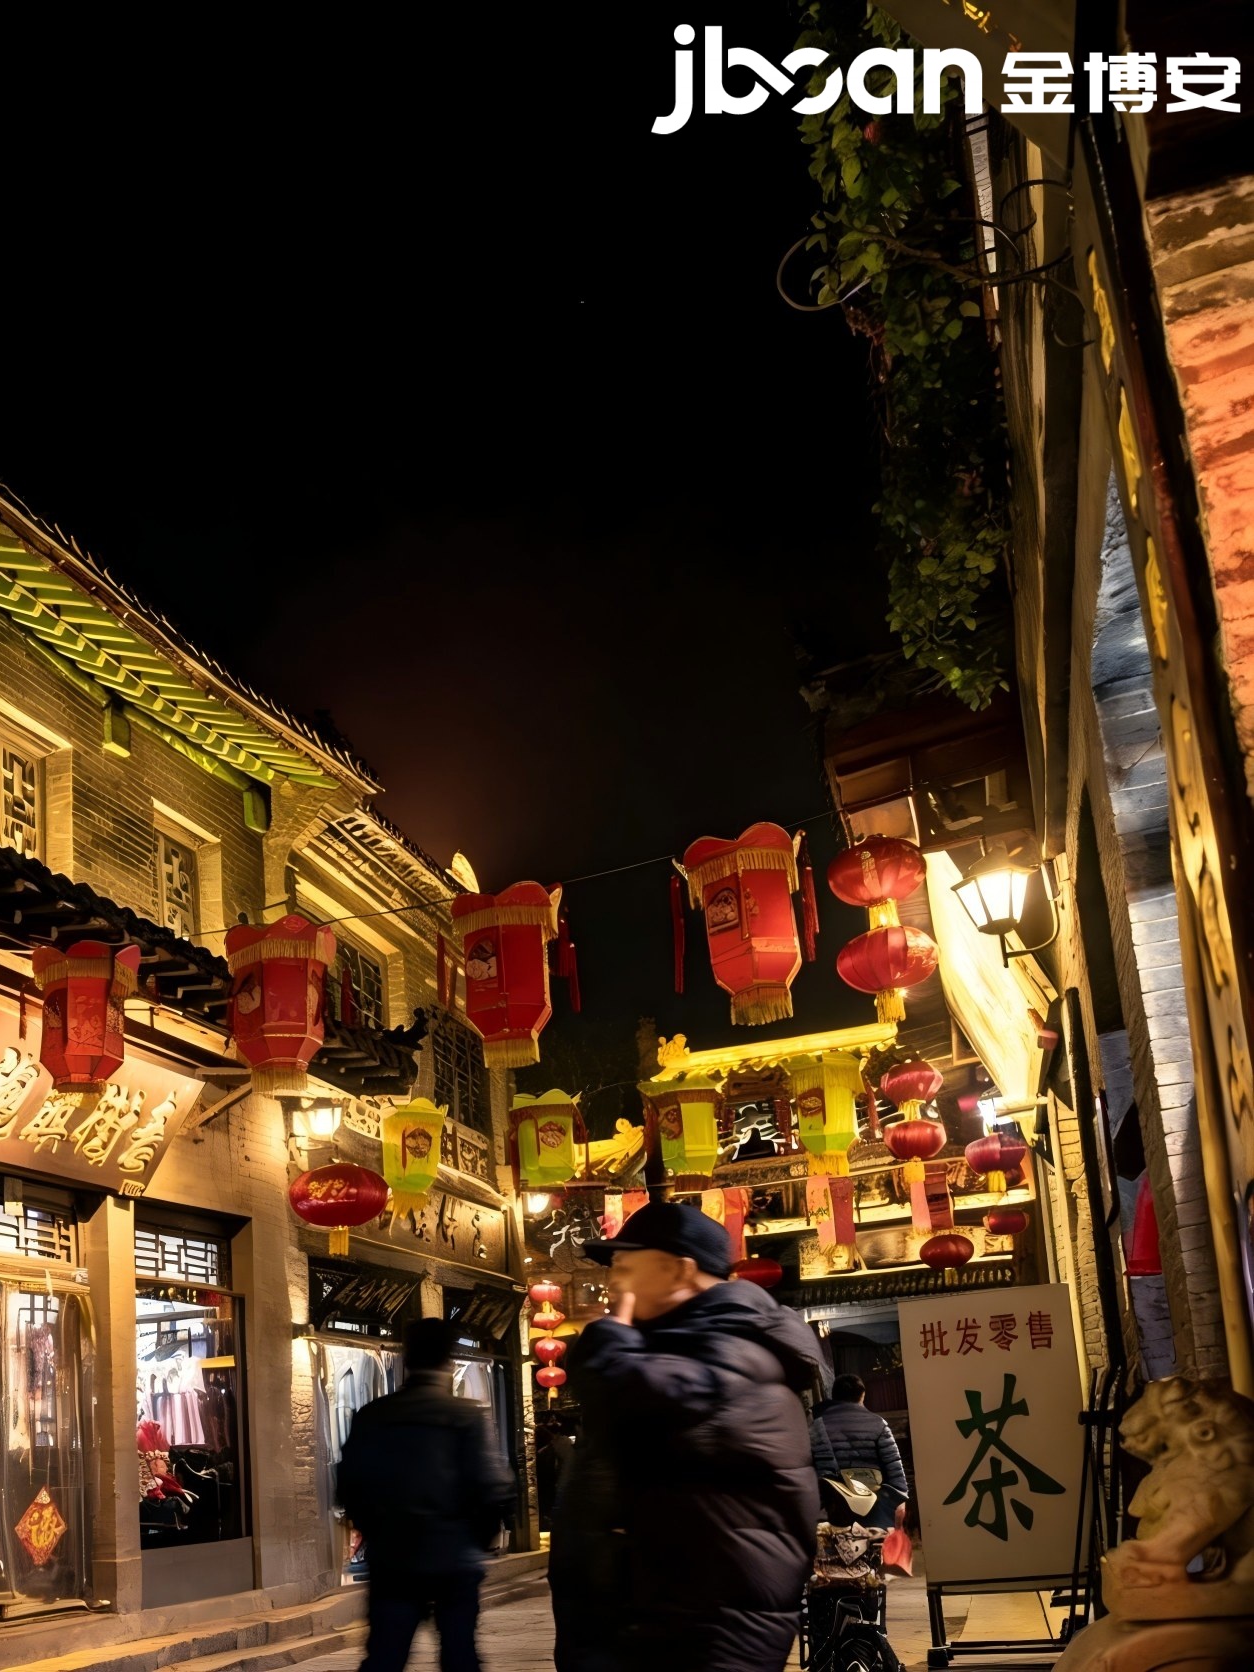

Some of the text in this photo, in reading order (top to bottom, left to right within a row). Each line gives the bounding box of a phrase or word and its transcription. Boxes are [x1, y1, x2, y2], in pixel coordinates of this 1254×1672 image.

[919, 1310, 1054, 1359] 批发零售
[942, 1373, 1066, 1541] 茶
